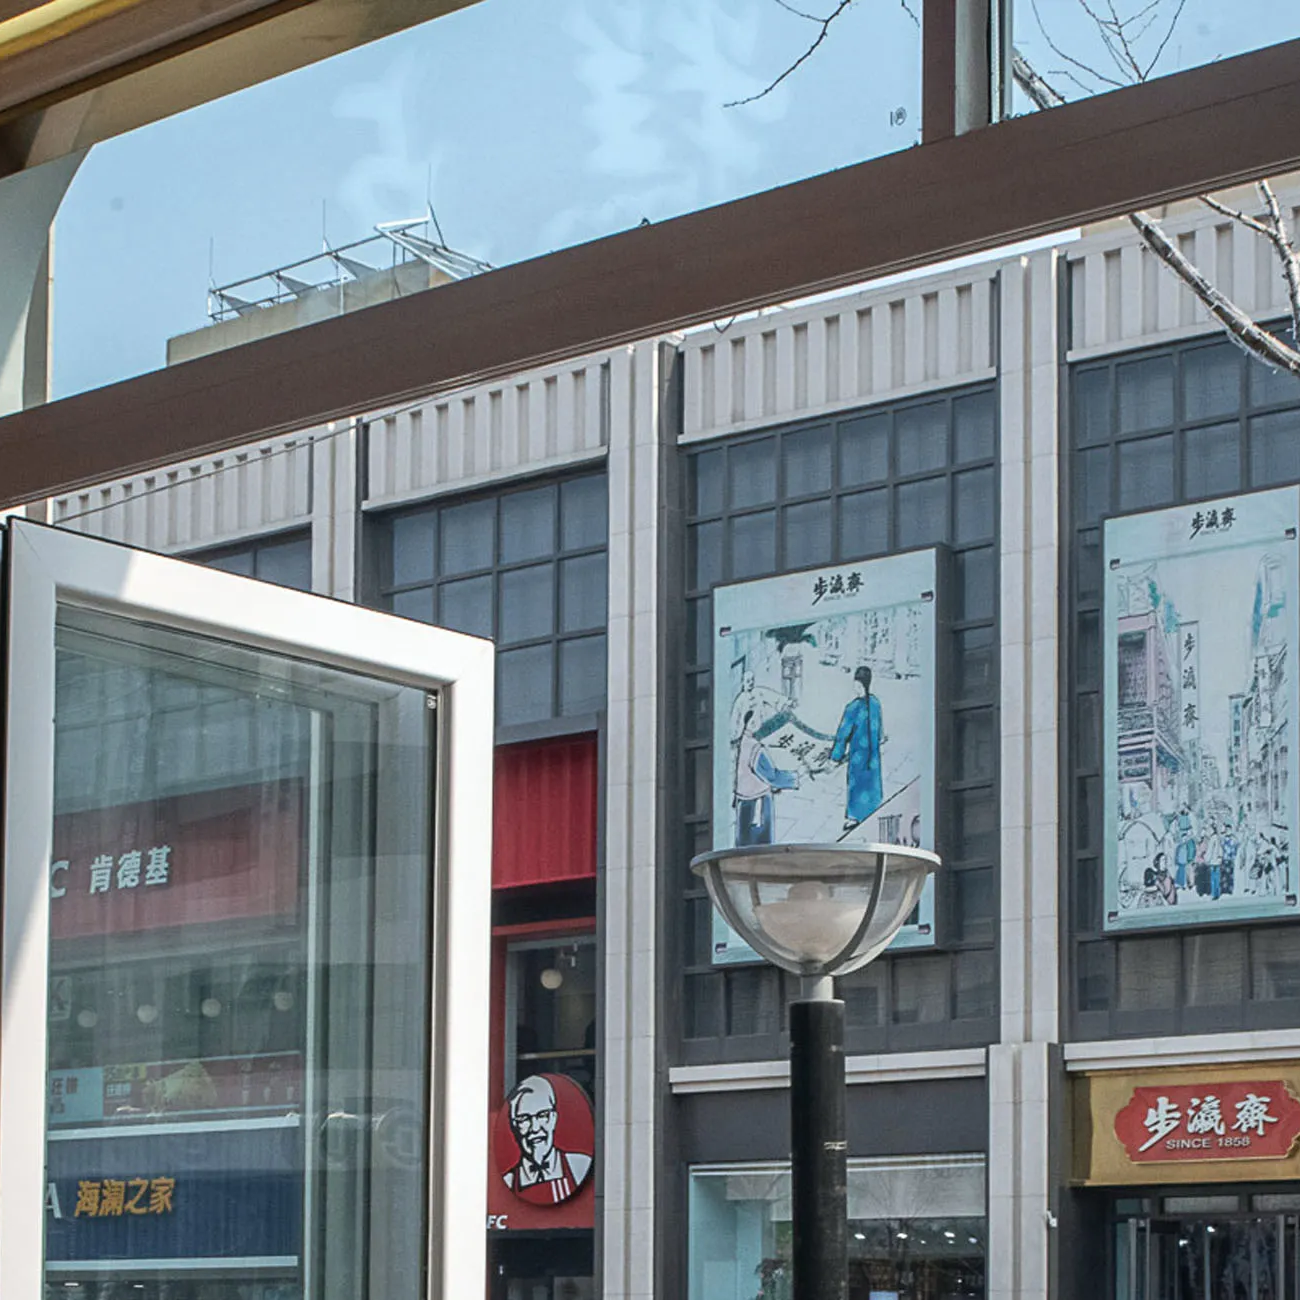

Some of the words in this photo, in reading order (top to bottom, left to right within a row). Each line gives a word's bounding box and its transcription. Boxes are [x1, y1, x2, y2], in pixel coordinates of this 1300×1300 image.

[89, 845, 172, 895] 肯德基
[1166, 1138, 1213, 1150] SINCE
[1218, 1135, 1251, 1147] 1858
[74, 1175, 175, 1218] 海澜之家
